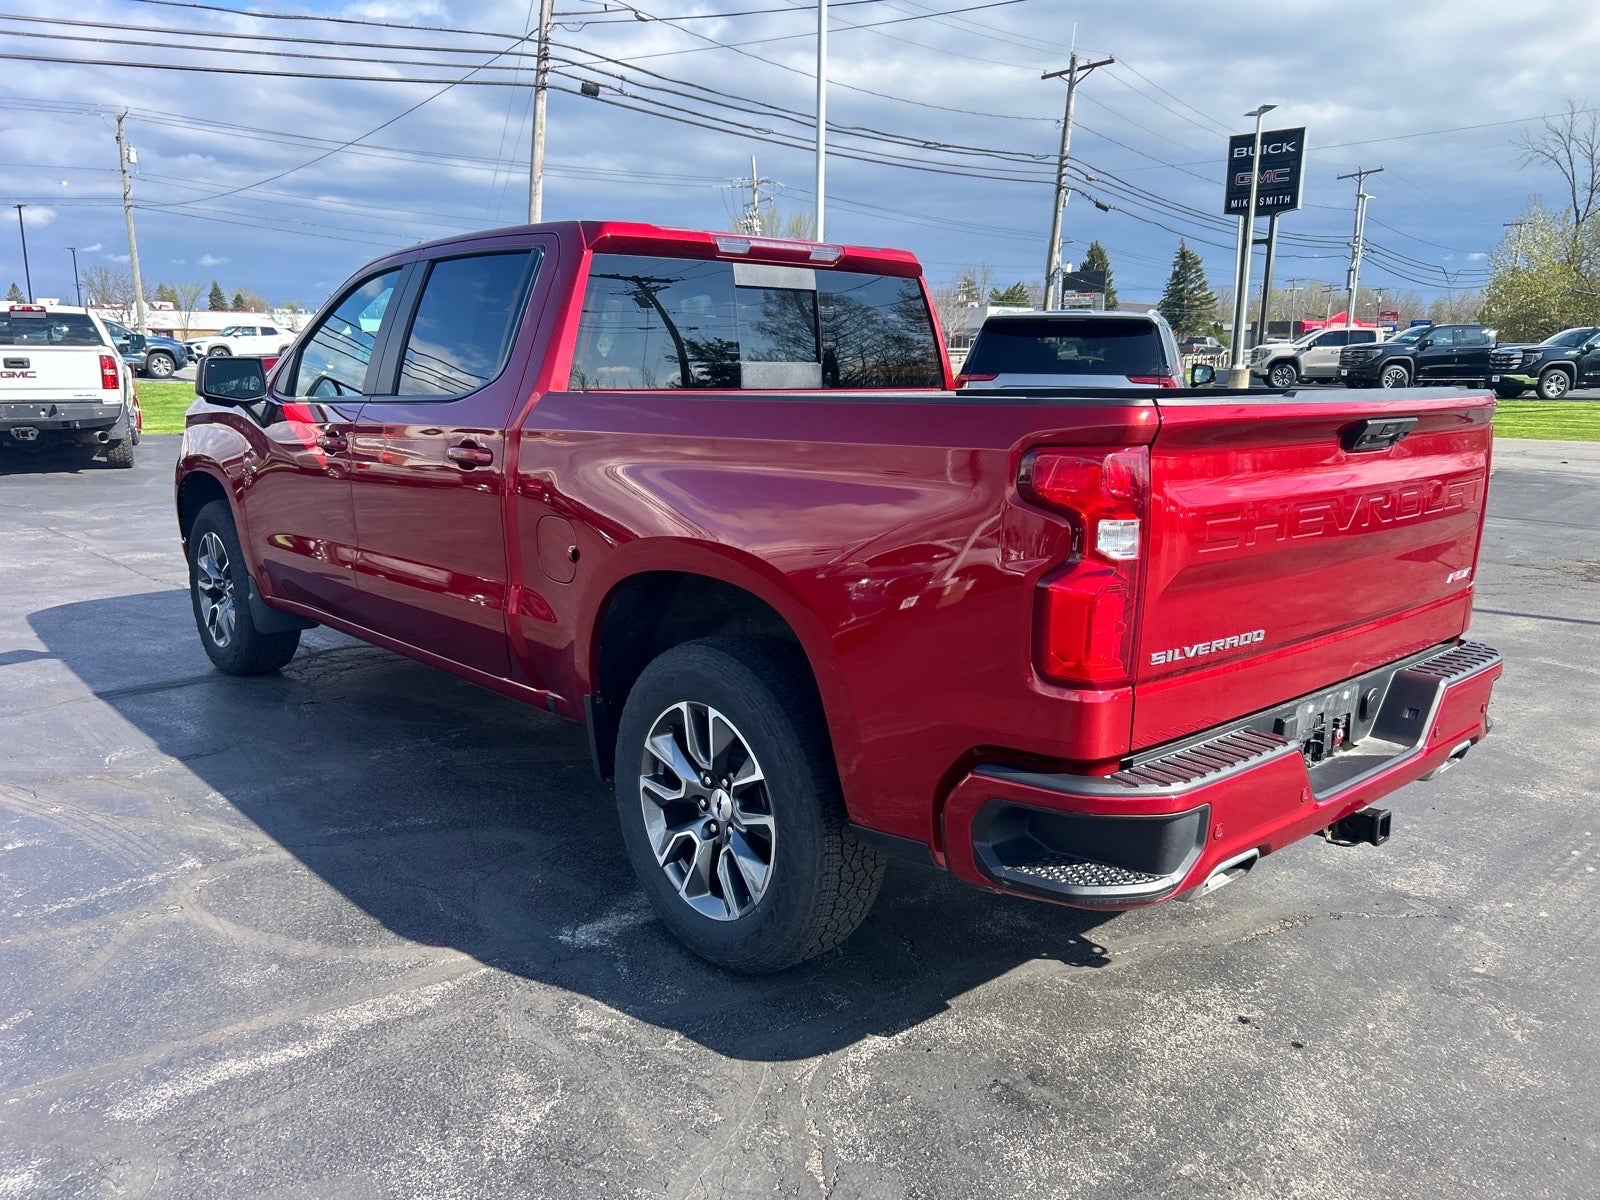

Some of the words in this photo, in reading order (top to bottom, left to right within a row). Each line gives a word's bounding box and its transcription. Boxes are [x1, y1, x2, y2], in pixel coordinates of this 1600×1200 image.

[1233, 141, 1296, 158] BUICK
[1235, 168, 1290, 186] GMC
[1231, 198, 1250, 208] MIK
[1259, 195, 1290, 206] SMITH
[0, 370, 37, 379] GMC
[1198, 478, 1482, 552] CHEVROLET
[1150, 629, 1265, 665] SILVERADO
